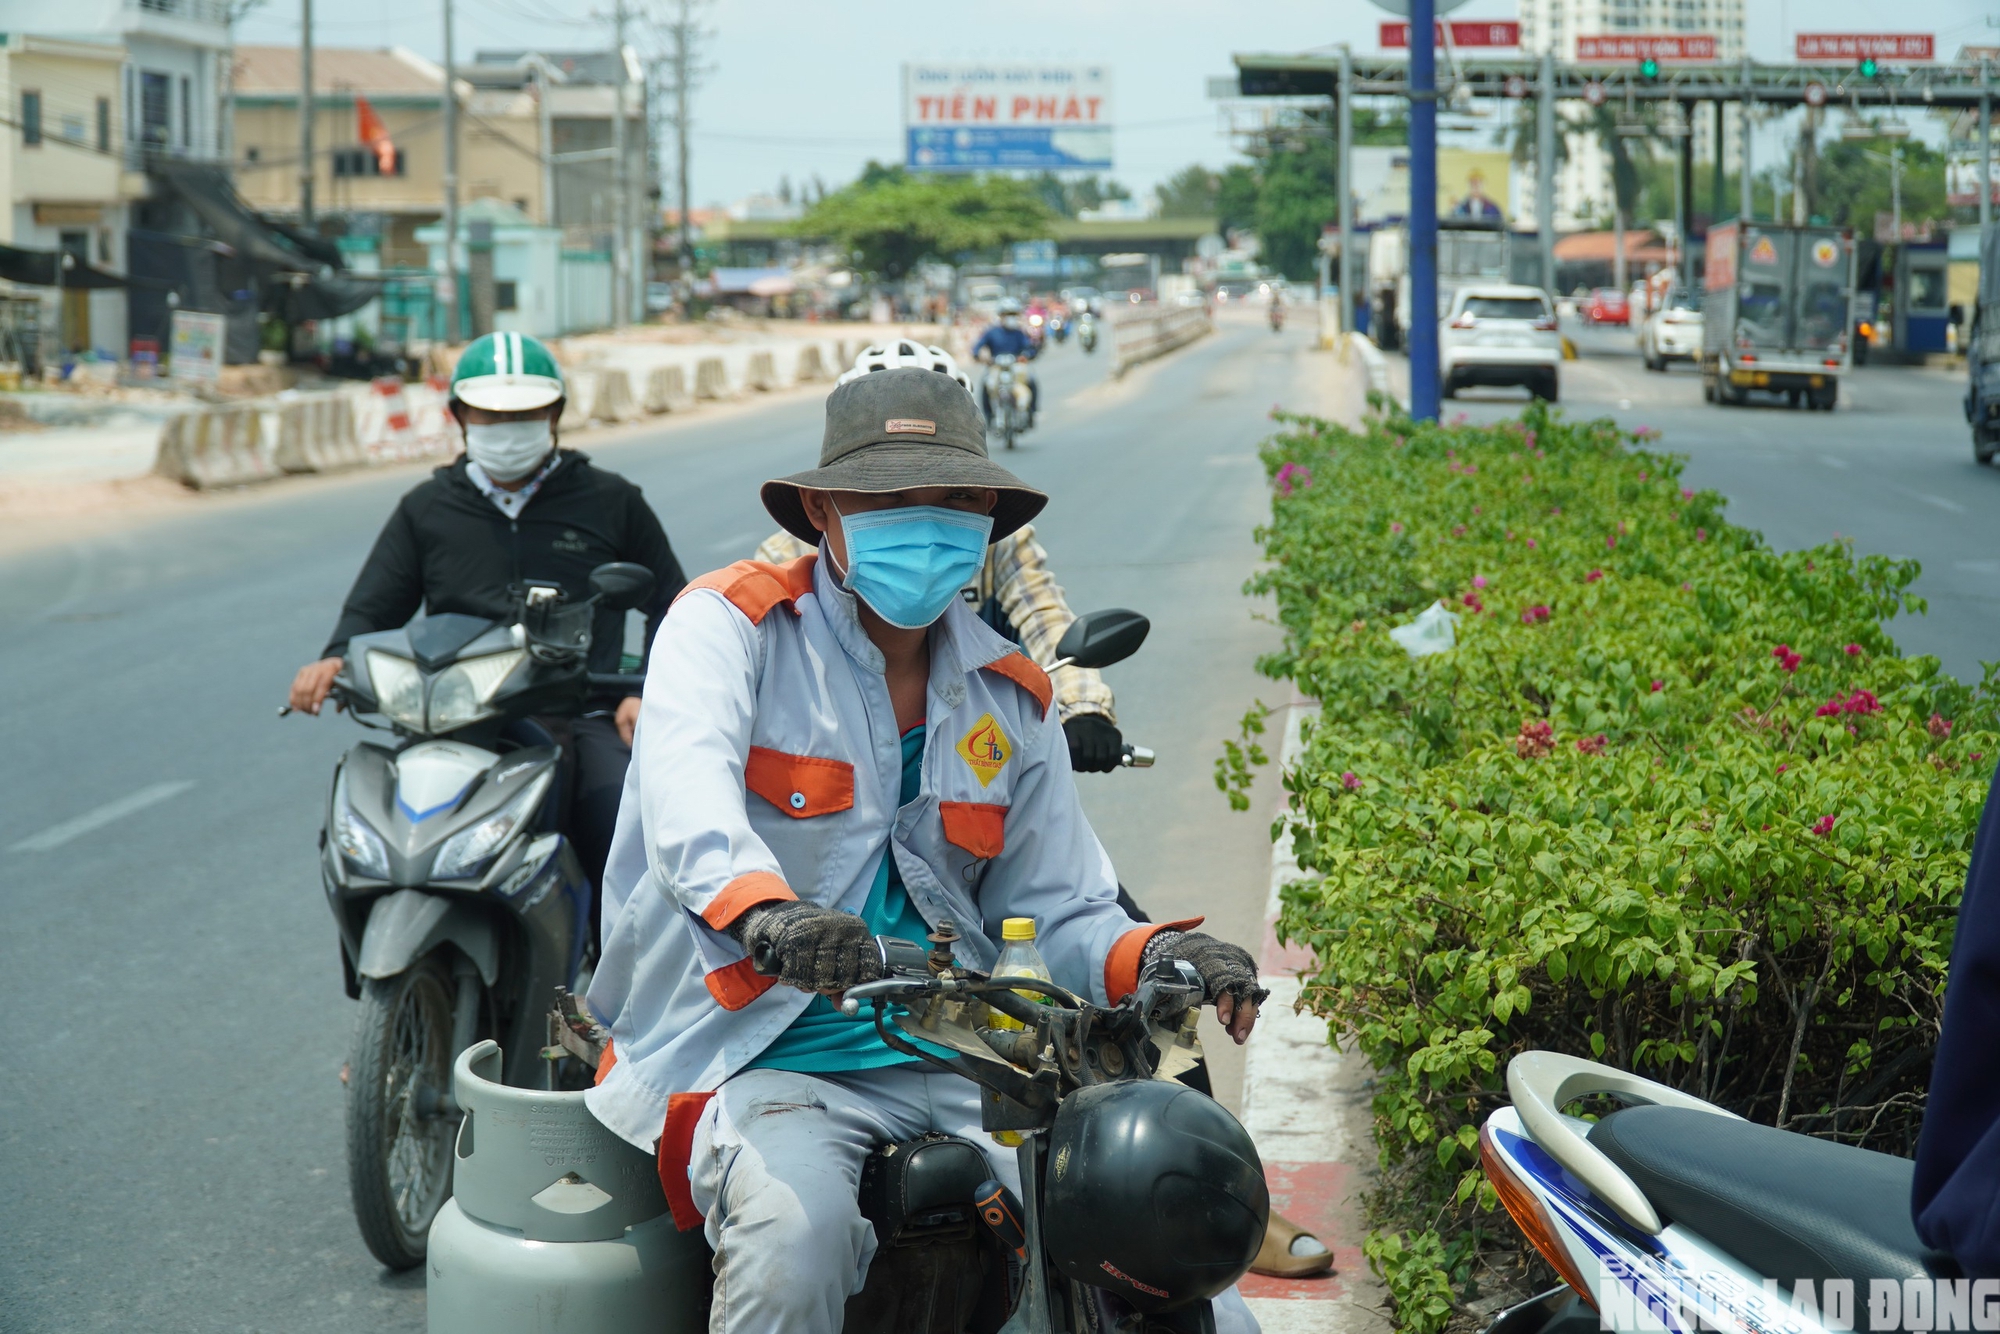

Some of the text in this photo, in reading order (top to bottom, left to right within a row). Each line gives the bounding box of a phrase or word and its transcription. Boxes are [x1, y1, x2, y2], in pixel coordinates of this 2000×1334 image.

[916, 83, 1103, 120] TIẾN PHÁT
[1099, 1260, 1170, 1298] HONDA
